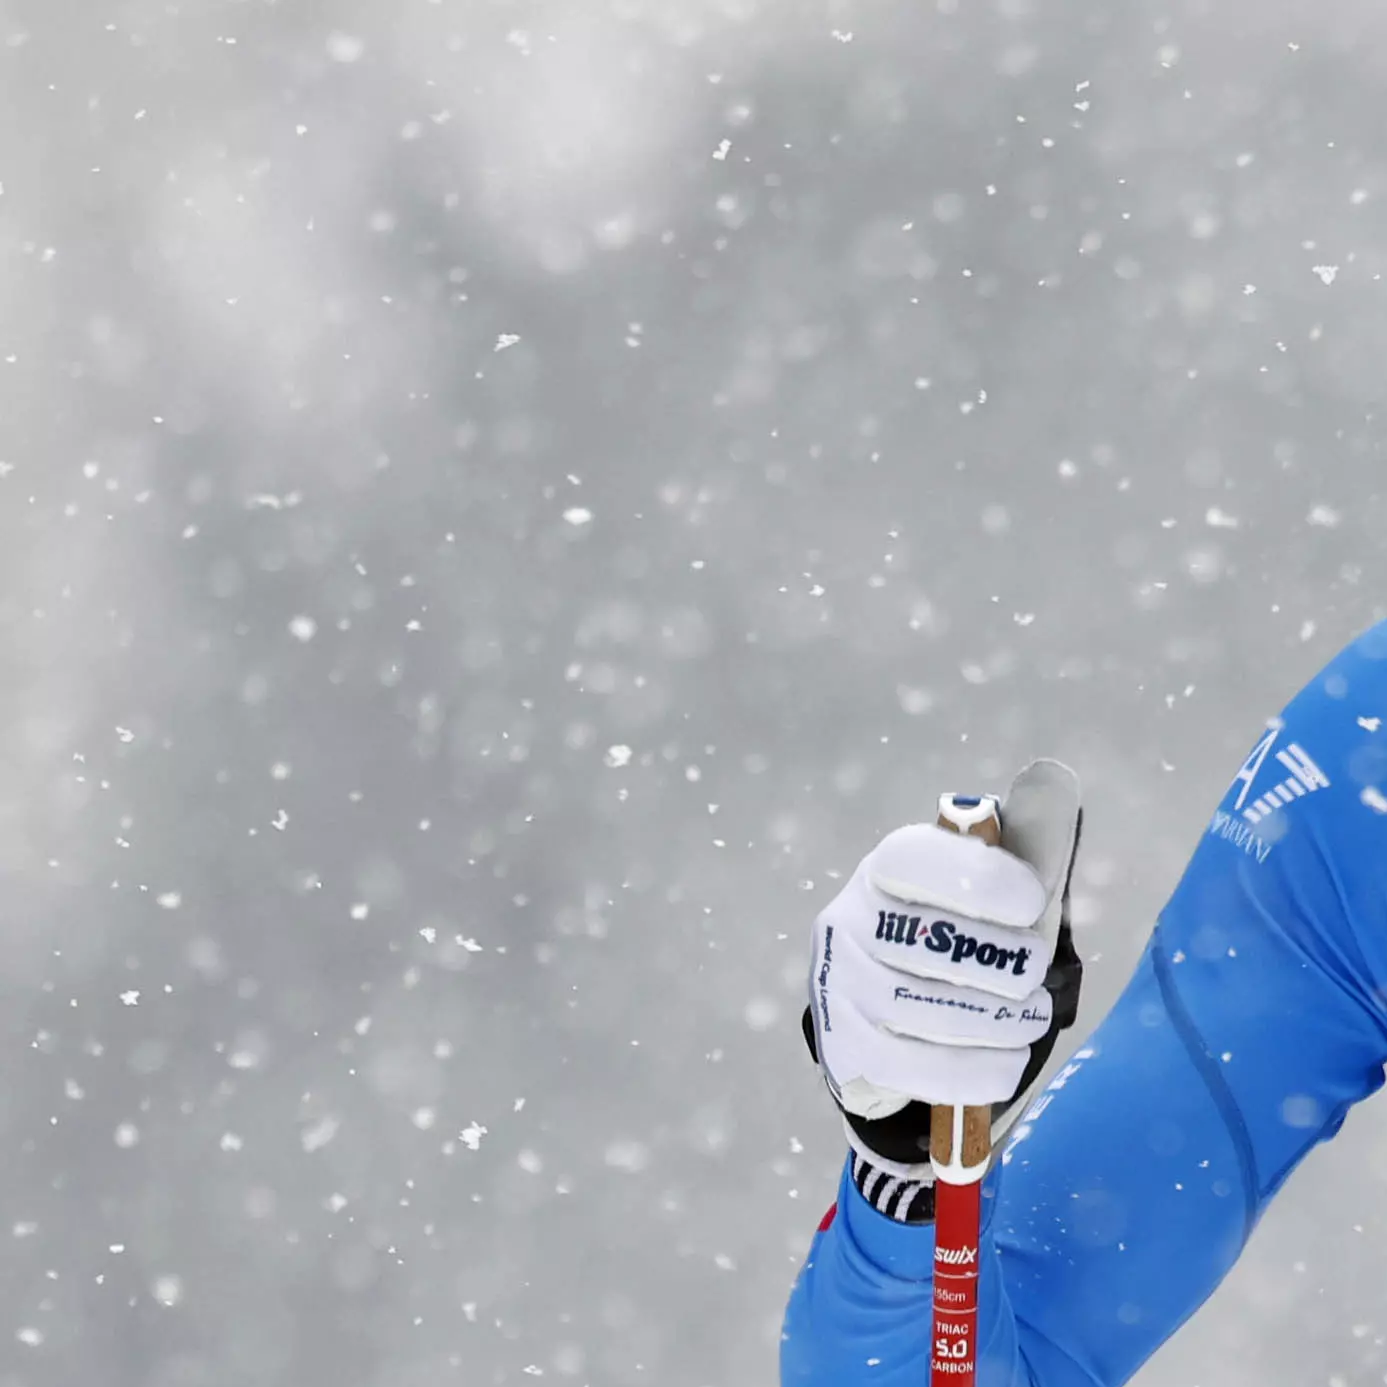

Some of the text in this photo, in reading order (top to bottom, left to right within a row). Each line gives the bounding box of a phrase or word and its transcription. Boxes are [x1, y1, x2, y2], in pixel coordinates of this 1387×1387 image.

[934, 1245, 978, 1265] swix
[936, 1321, 969, 1335] TRIAC
[935, 1338, 968, 1358] 5.0
[931, 1359, 973, 1374] CARBON
